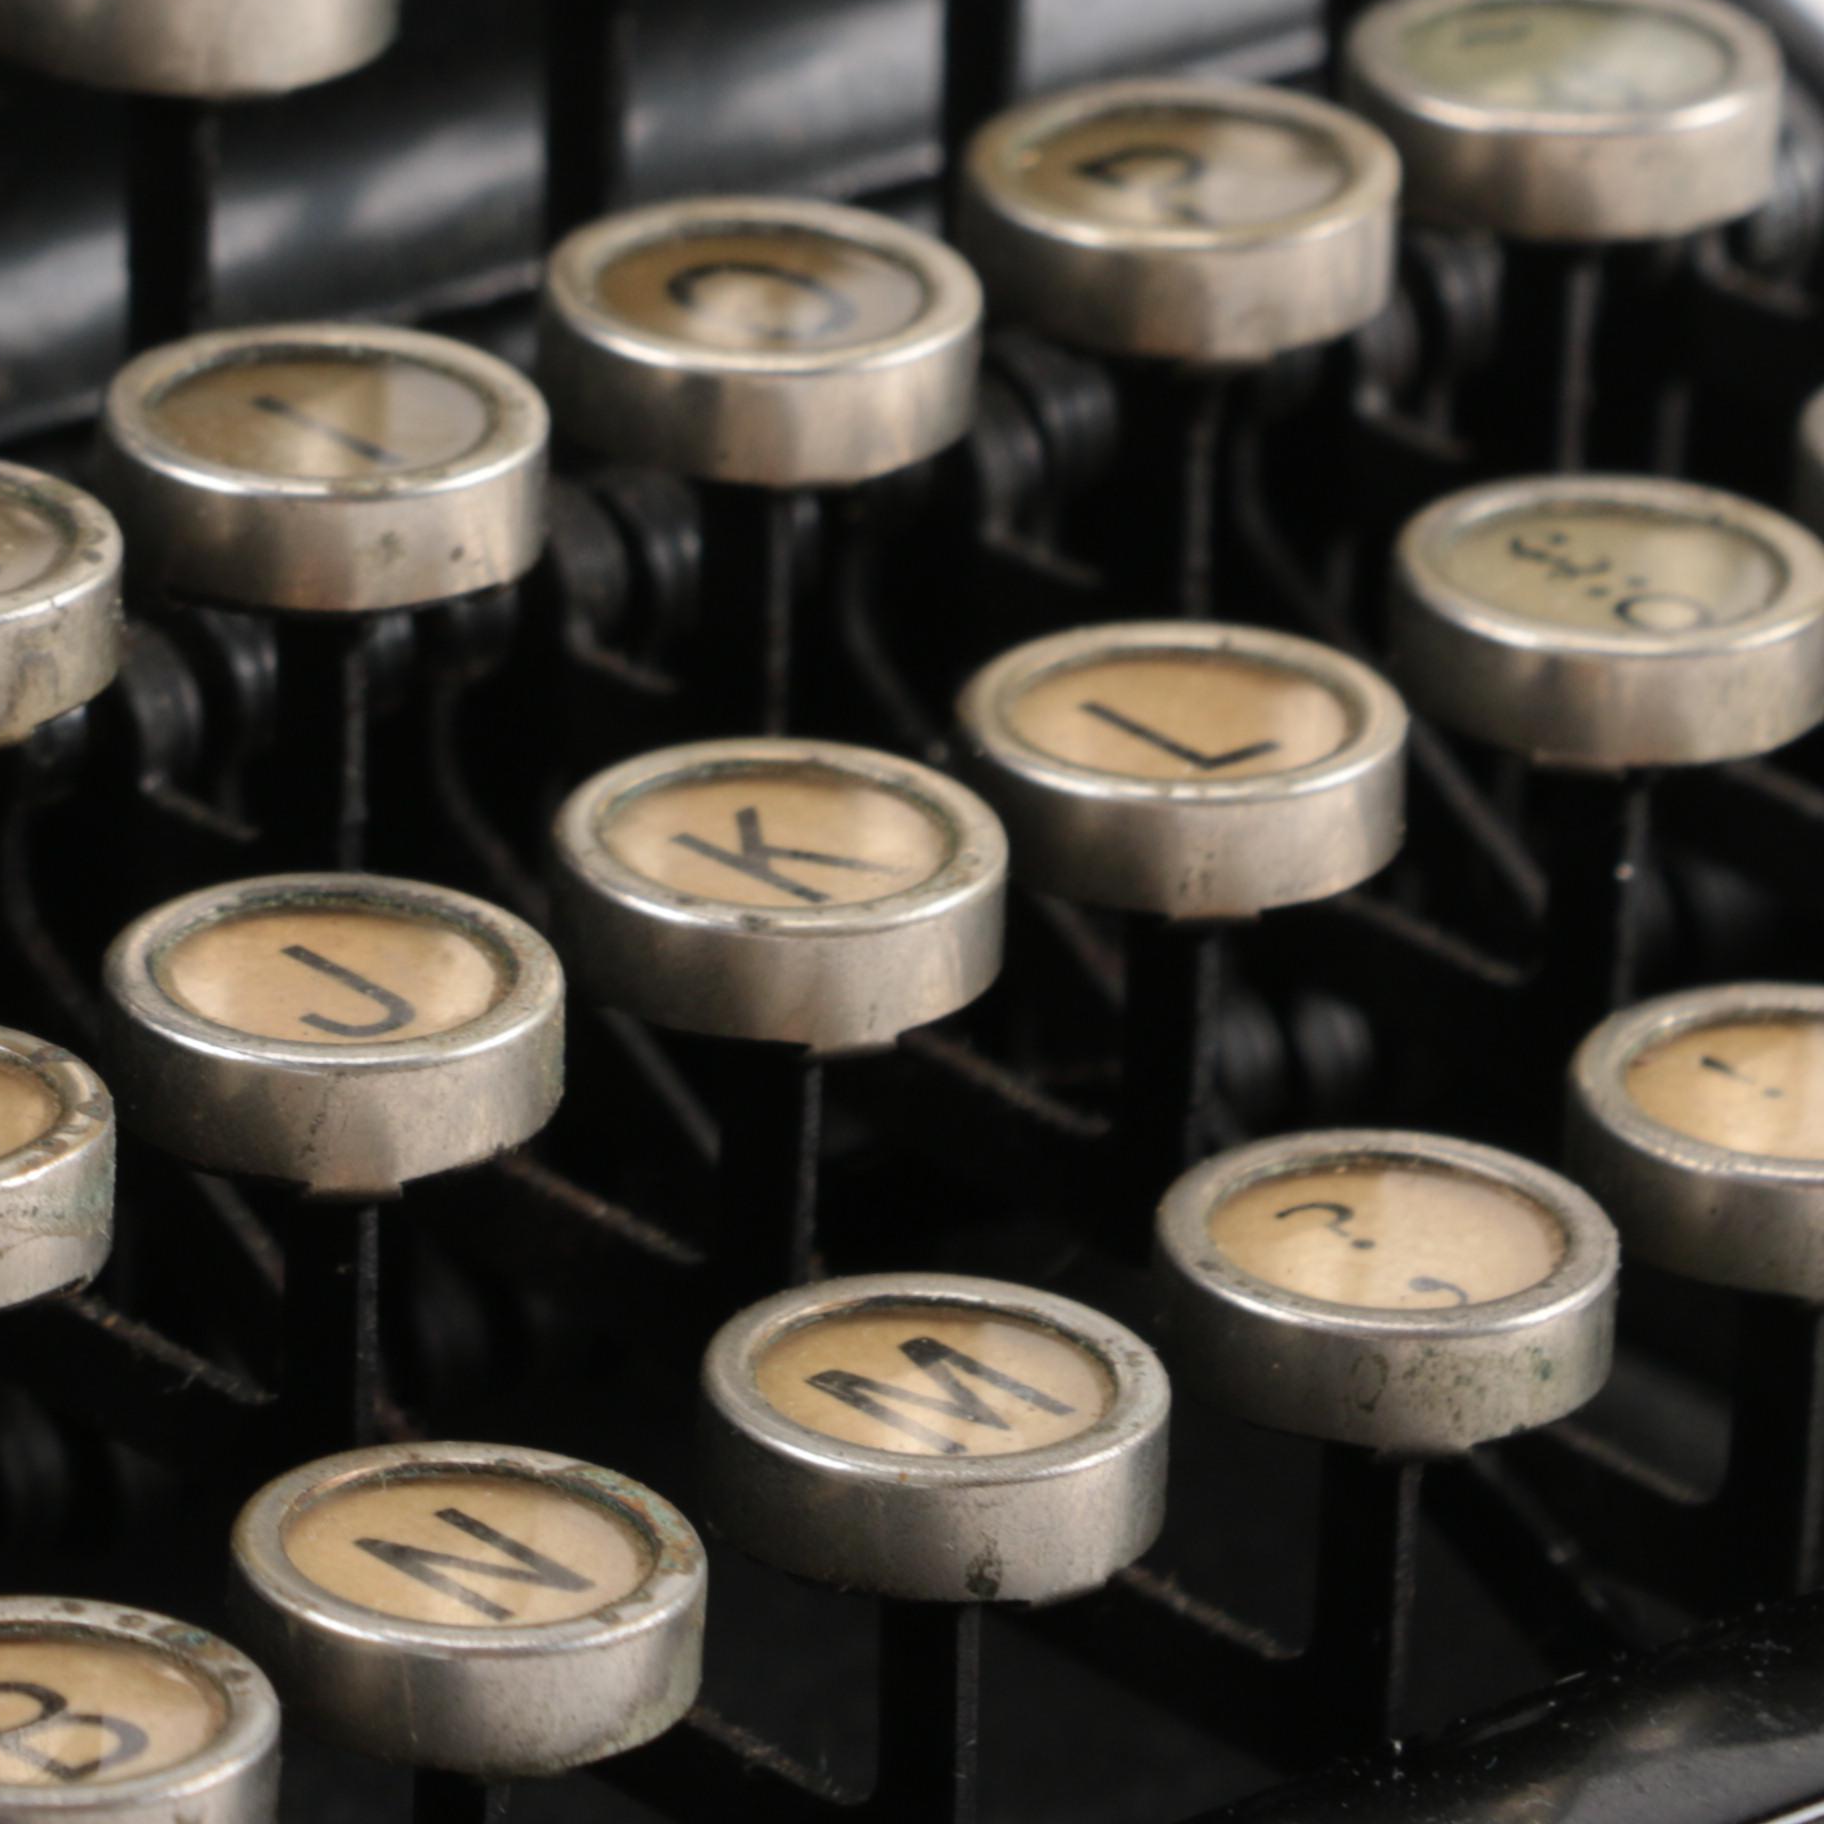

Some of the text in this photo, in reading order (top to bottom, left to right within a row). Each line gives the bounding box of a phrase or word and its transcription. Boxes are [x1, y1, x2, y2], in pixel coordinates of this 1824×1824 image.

[1078, 700, 1282, 773] L
[671, 806, 912, 904] K
[279, 944, 416, 1039] J
[1274, 1201, 1377, 1250] ?
[802, 1333, 1077, 1455] M
[355, 1506, 596, 1622] N
